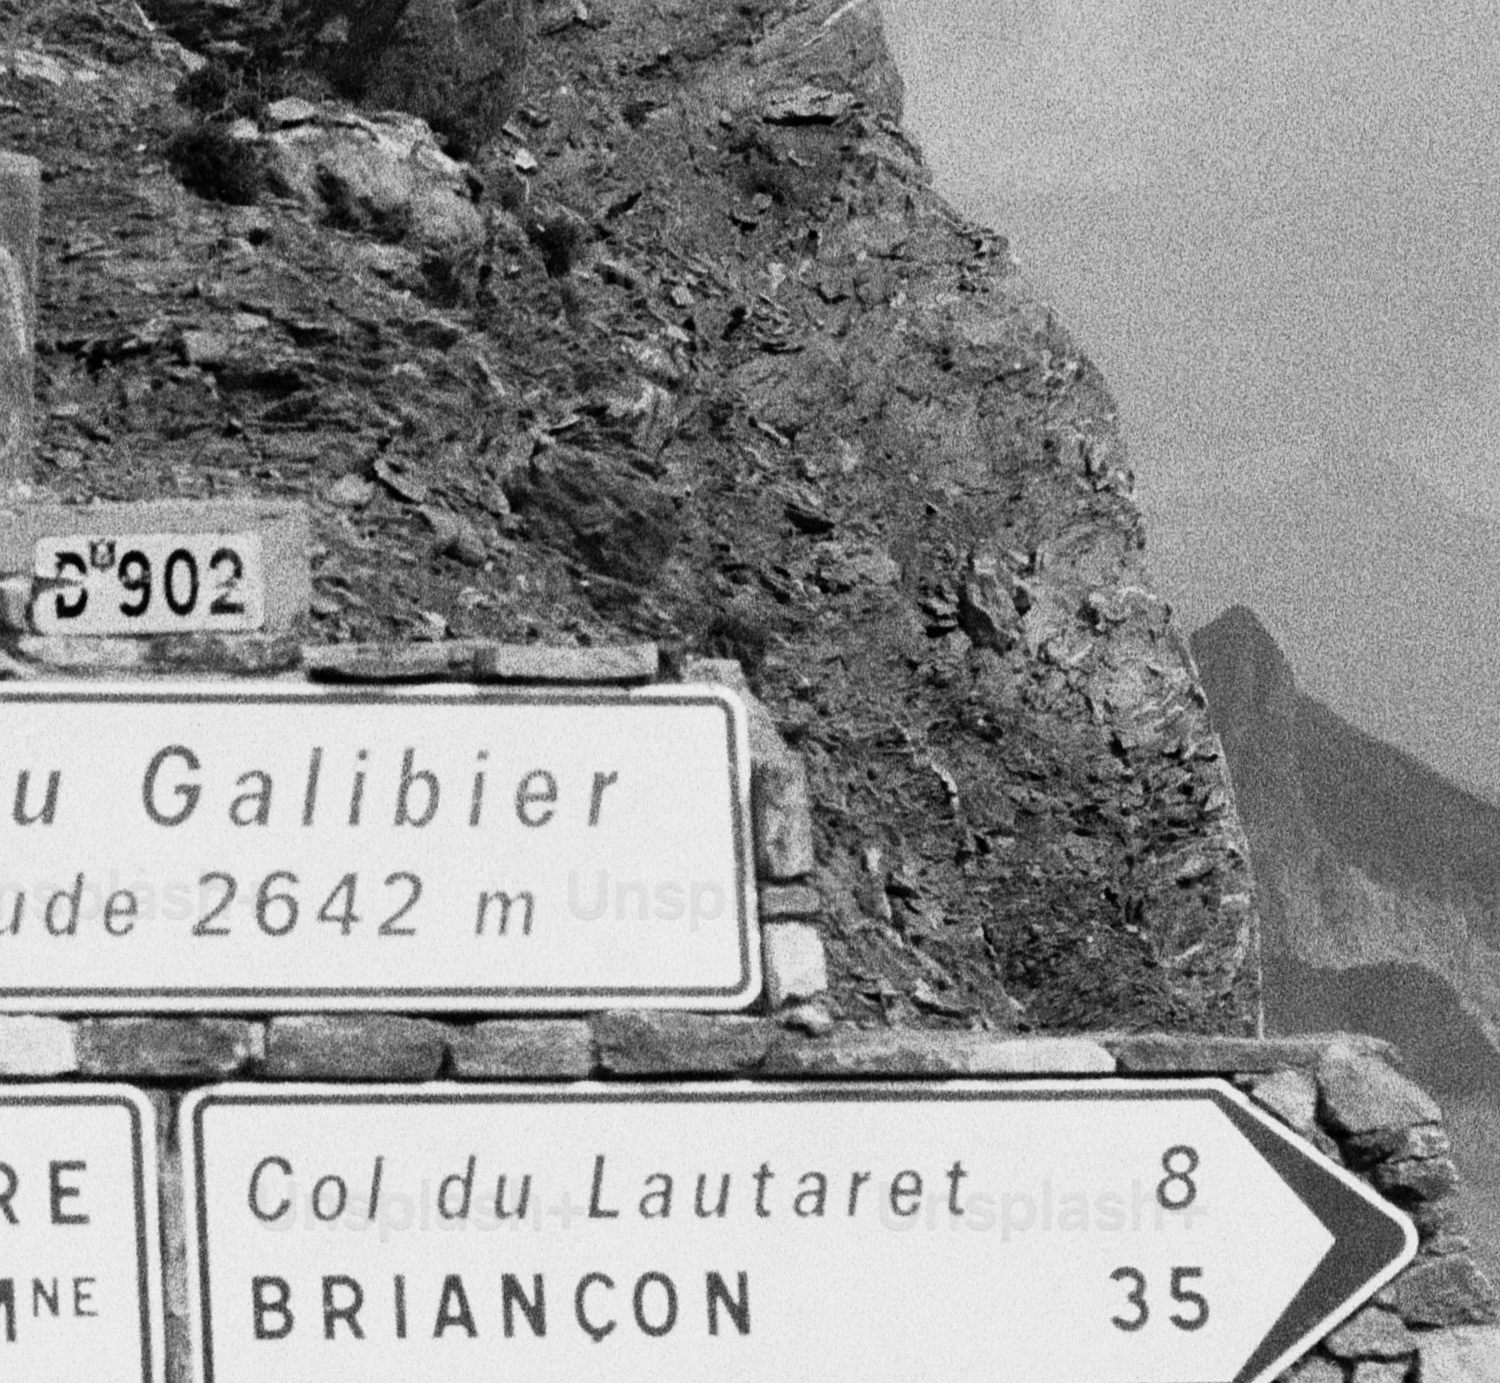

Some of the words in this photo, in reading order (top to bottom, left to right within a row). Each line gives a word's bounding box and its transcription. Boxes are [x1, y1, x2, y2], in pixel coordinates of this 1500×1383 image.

[139, 744, 623, 829] Galibier
[191, 870, 425, 938] 2642
[474, 891, 536, 937] m
[246, 1153, 385, 1224] Col
[435, 1153, 533, 1221] du
[586, 1152, 973, 1220] Lautaret
[1154, 1143, 1202, 1213] 8
[250, 1269, 754, 1344] BRIANÇON
[1107, 1265, 1212, 1334] 35
